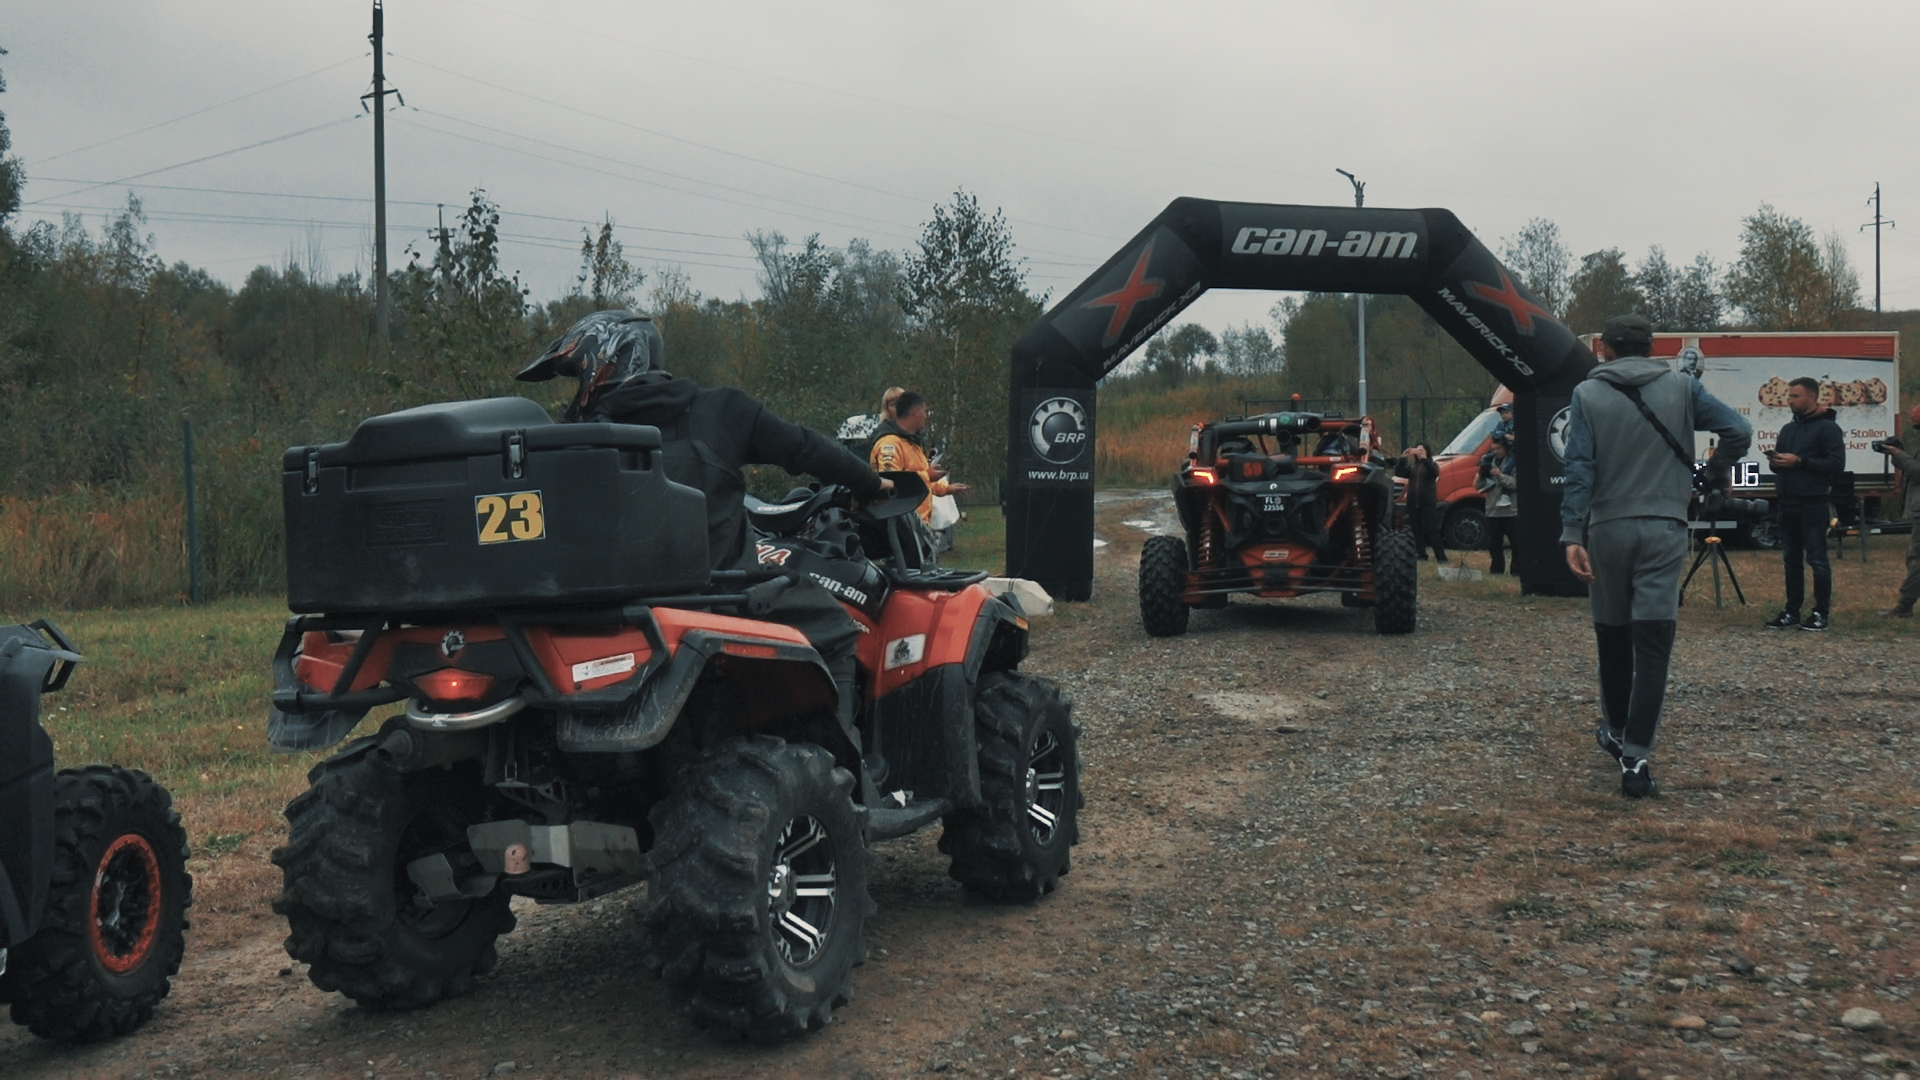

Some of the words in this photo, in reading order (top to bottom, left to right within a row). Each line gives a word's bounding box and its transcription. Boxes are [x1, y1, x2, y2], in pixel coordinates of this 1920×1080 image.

[1231, 227, 1415, 259] can-am
[1103, 301, 1177, 370] MAVERICK
[1437, 287, 1513, 356] MAVERICK
[1507, 355, 1534, 376] X3
[1054, 432, 1086, 443] BRP
[1850, 428, 1887, 439] Stollen
[1028, 469, 1089, 482] www.brp.ua
[477, 493, 543, 543] 23
